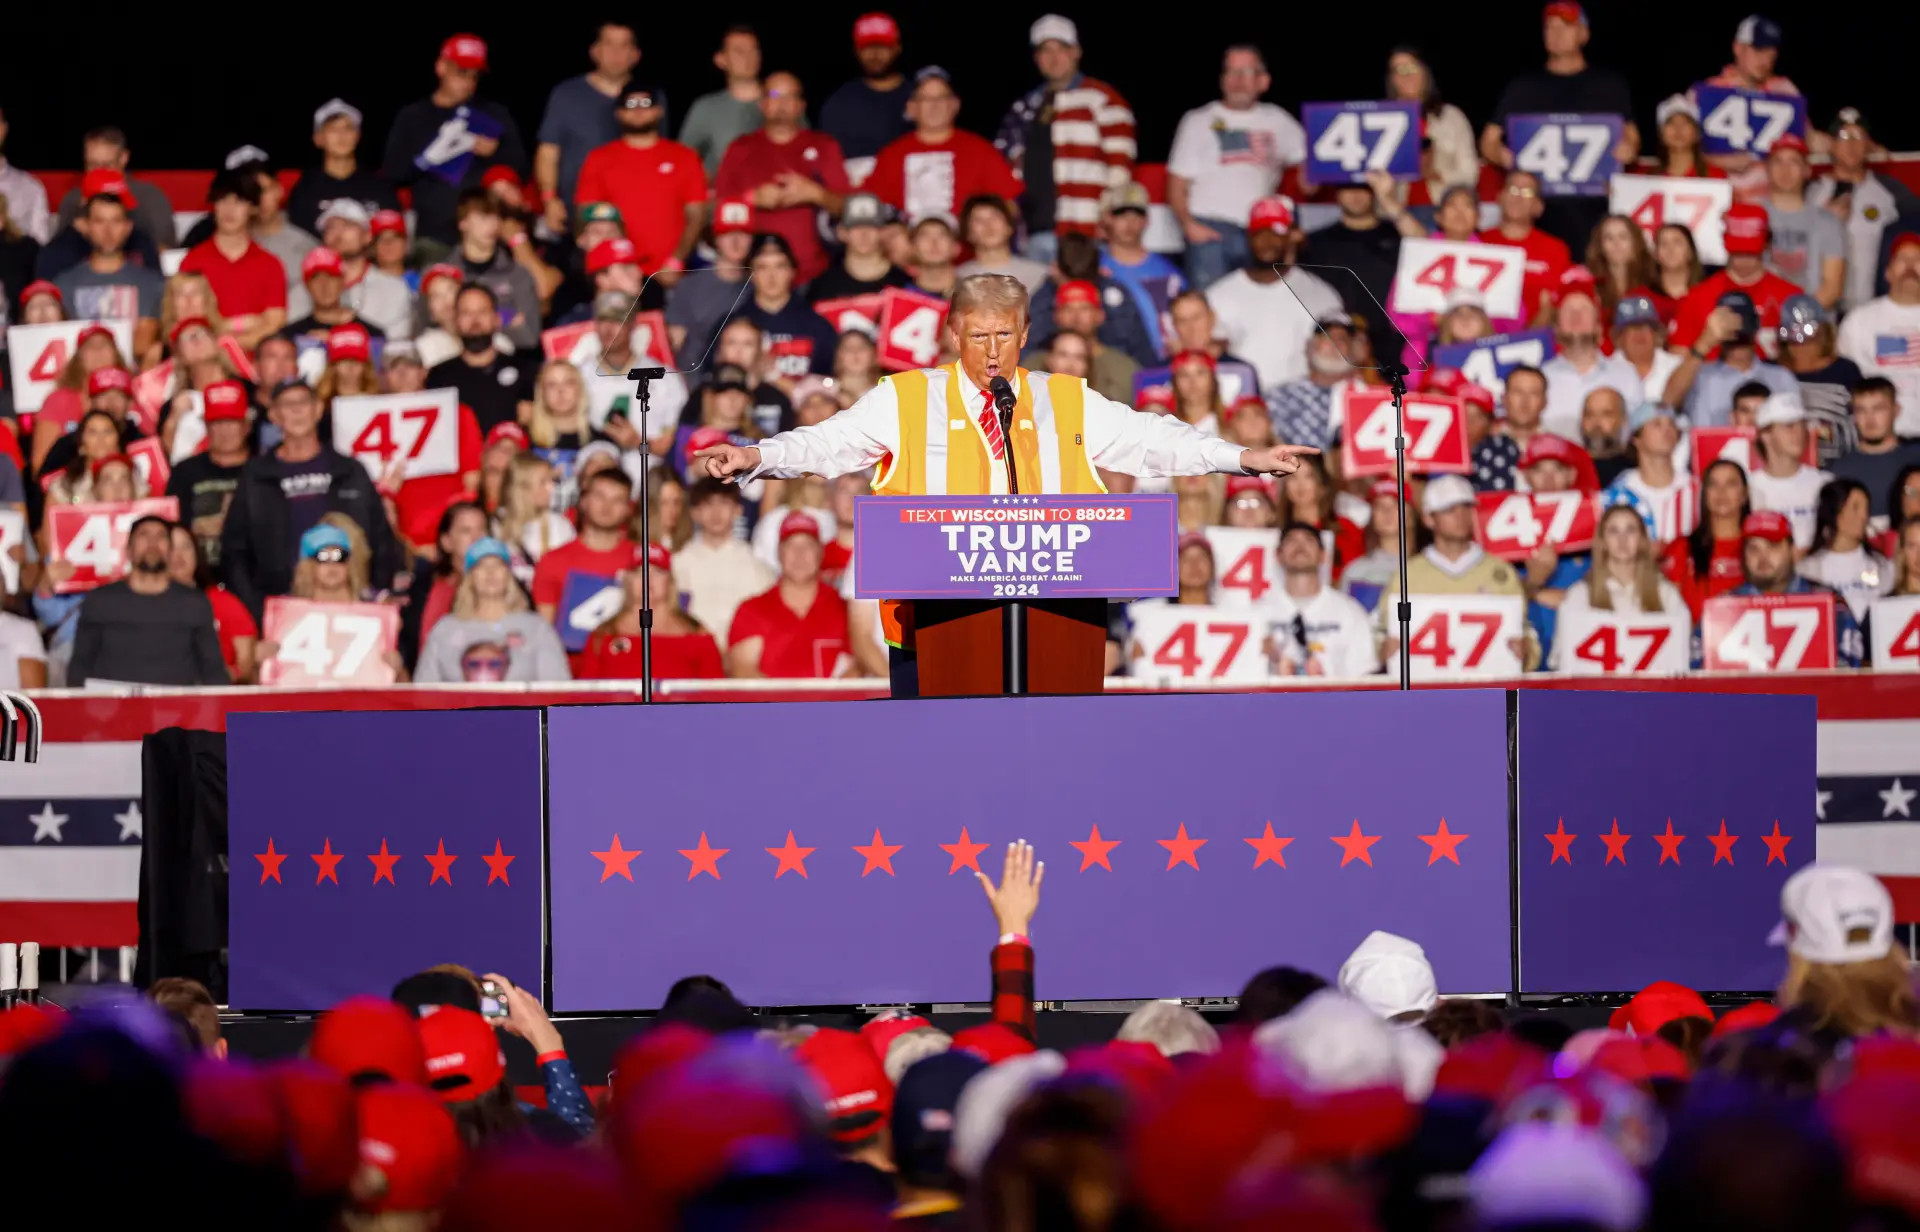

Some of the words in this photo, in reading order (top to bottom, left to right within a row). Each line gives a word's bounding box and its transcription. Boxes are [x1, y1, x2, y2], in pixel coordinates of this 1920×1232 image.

[1314, 111, 1409, 171] 47
[1704, 96, 1795, 151] 47
[1517, 125, 1611, 182] 47
[1632, 193, 1714, 243] 47
[1416, 255, 1507, 293] 47
[28, 338, 68, 383] 4
[890, 308, 940, 362] 4
[352, 407, 440, 461] 47
[1355, 402, 1453, 460] 47
[906, 510, 946, 522] TEXT
[951, 508, 1045, 522] WISCONSIN
[1051, 509, 1072, 521] TO
[1076, 508, 1125, 521] 88022
[940, 524, 1091, 551] TRUMP
[1486, 490, 1582, 547] 47
[950, 575, 975, 583] MAKE
[977, 575, 1017, 583] AMERICA
[1051, 574, 1082, 582] AGAIN!
[957, 551, 1074, 573] VANCE
[1220, 546, 1270, 600] 4
[993, 584, 1039, 596] 2024
[277, 612, 382, 677] 47
[1153, 622, 1250, 677] 47
[1409, 612, 1503, 668] 47
[1576, 625, 1672, 672] 47
[1718, 606, 1820, 671] 47
[1889, 611, 1920, 667] 4
